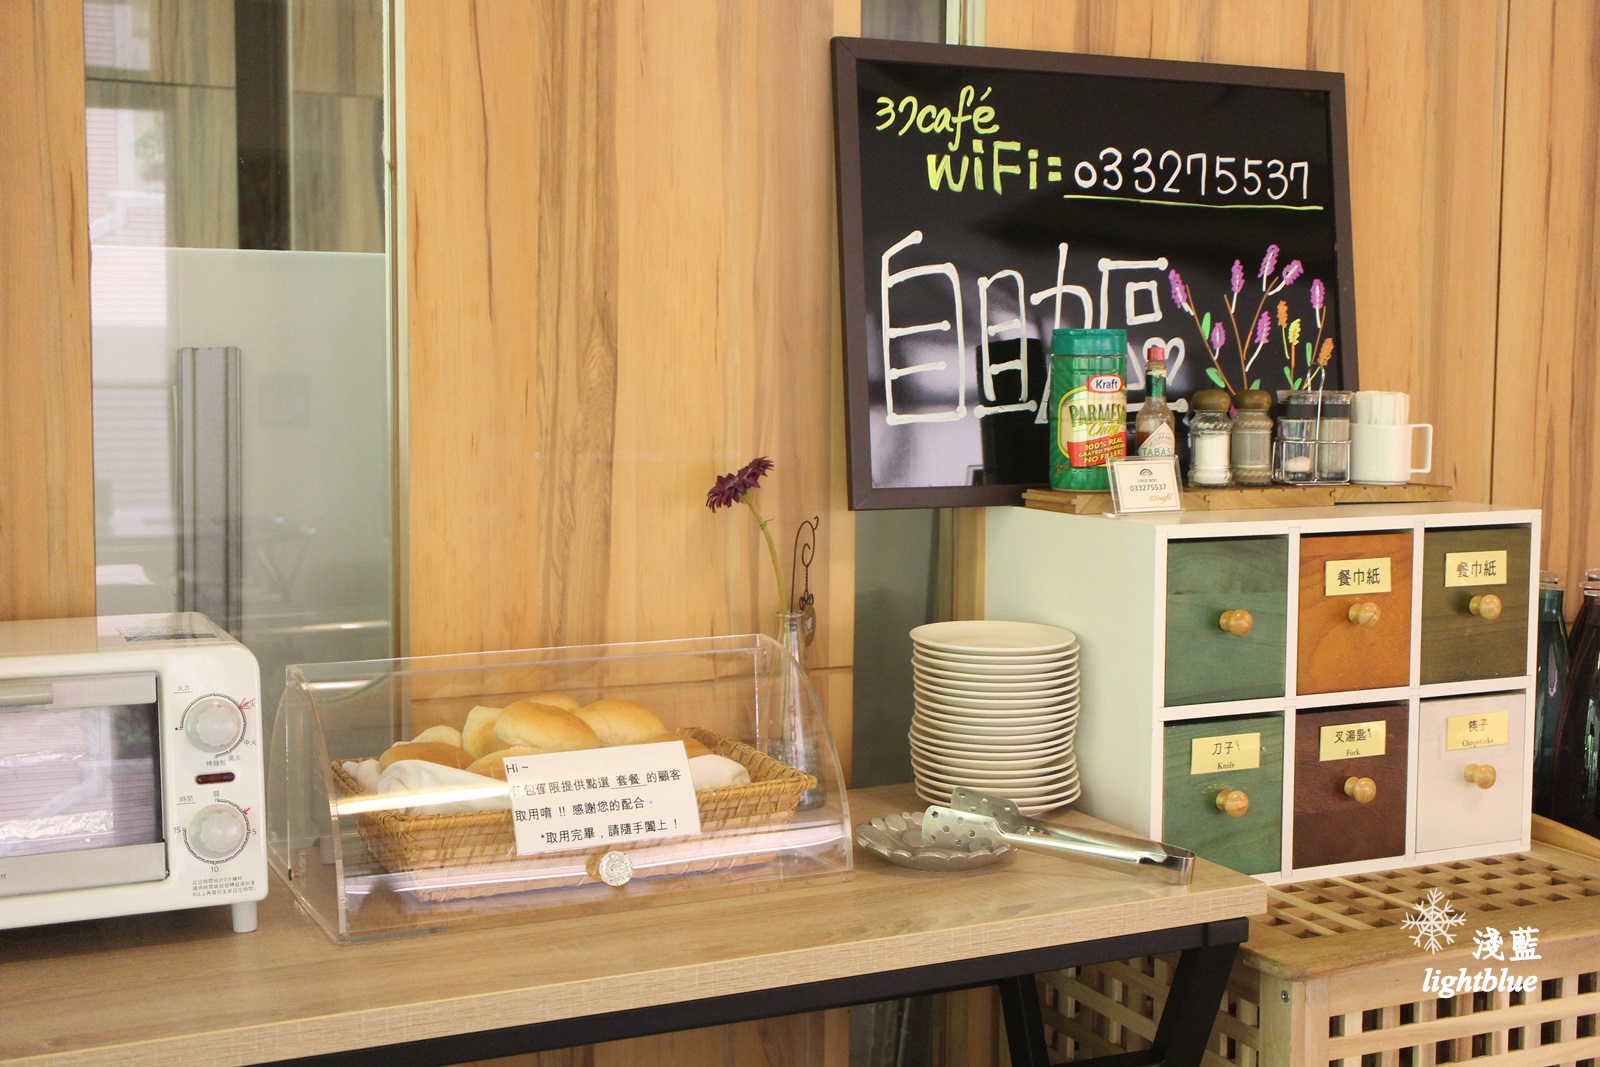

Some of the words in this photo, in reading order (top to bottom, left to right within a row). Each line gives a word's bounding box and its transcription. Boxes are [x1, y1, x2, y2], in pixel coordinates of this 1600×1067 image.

[1074, 147, 1310, 200] 033275537
[1095, 379, 1118, 391] Kraft
[1085, 440, 1107, 451] 100%
[1109, 437, 1124, 446] REAL
[1084, 454, 1099, 464] NO
[1100, 449, 1124, 461] FILLERS
[1129, 484, 1167, 492] 033275537
[1336, 567, 1381, 587] 餐巾紙
[1456, 560, 1497, 579] 餐巾紙
[1468, 718, 1488, 733] 筷子
[1334, 728, 1367, 744] 叉湯匙
[1212, 741, 1234, 756] 刀子
[1346, 749, 1360, 757] Fork
[1217, 761, 1236, 770] Knife
[616, 773, 641, 786] 套餐
[645, 769, 681, 784] 的顧客
[515, 807, 552, 822] 取用唷
